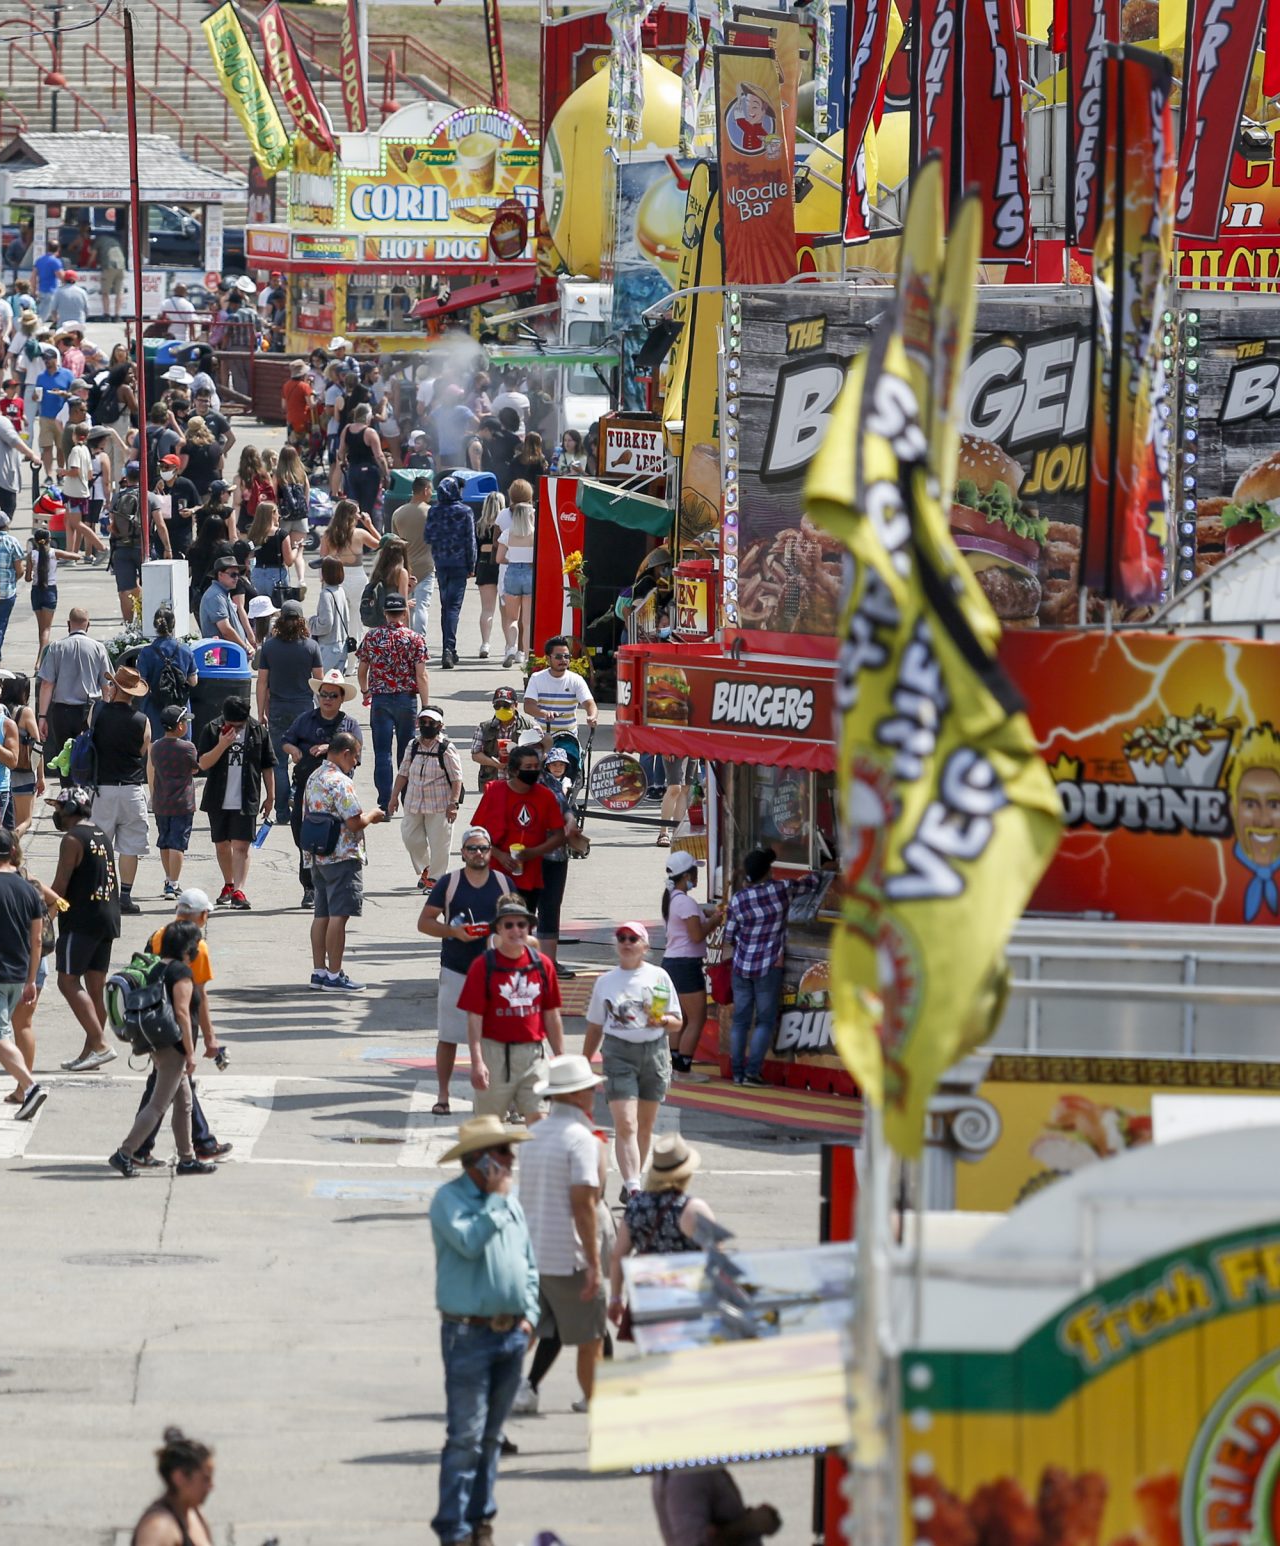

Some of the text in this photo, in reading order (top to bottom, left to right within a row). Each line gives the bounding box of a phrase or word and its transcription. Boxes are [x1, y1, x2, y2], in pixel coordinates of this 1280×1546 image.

[448, 115, 481, 140] FOOT
[982, 0, 1026, 249] FRIES
[1072, 0, 1108, 243] URGERS
[418, 151, 456, 162] Fresh
[350, 185, 449, 222] CORN
[726, 183, 788, 206] Noodle
[737, 200, 773, 222] Bar
[380, 239, 482, 260] HOT DOG
[785, 318, 824, 350] THE
[1236, 341, 1265, 358] THE
[767, 336, 1091, 473] BGE
[608, 430, 657, 450] TURKEY
[636, 453, 663, 473] LEGS
[560, 511, 577, 522] Coca-Cola
[711, 682, 814, 730] BURGERS
[593, 769, 619, 781] BUTTER
[599, 760, 624, 771] PEANUT
[592, 780, 615, 790] BACON
[594, 786, 622, 798] BURGER
[1060, 1263, 1212, 1365] Fresh
[1204, 1402, 1278, 1546] RIED
